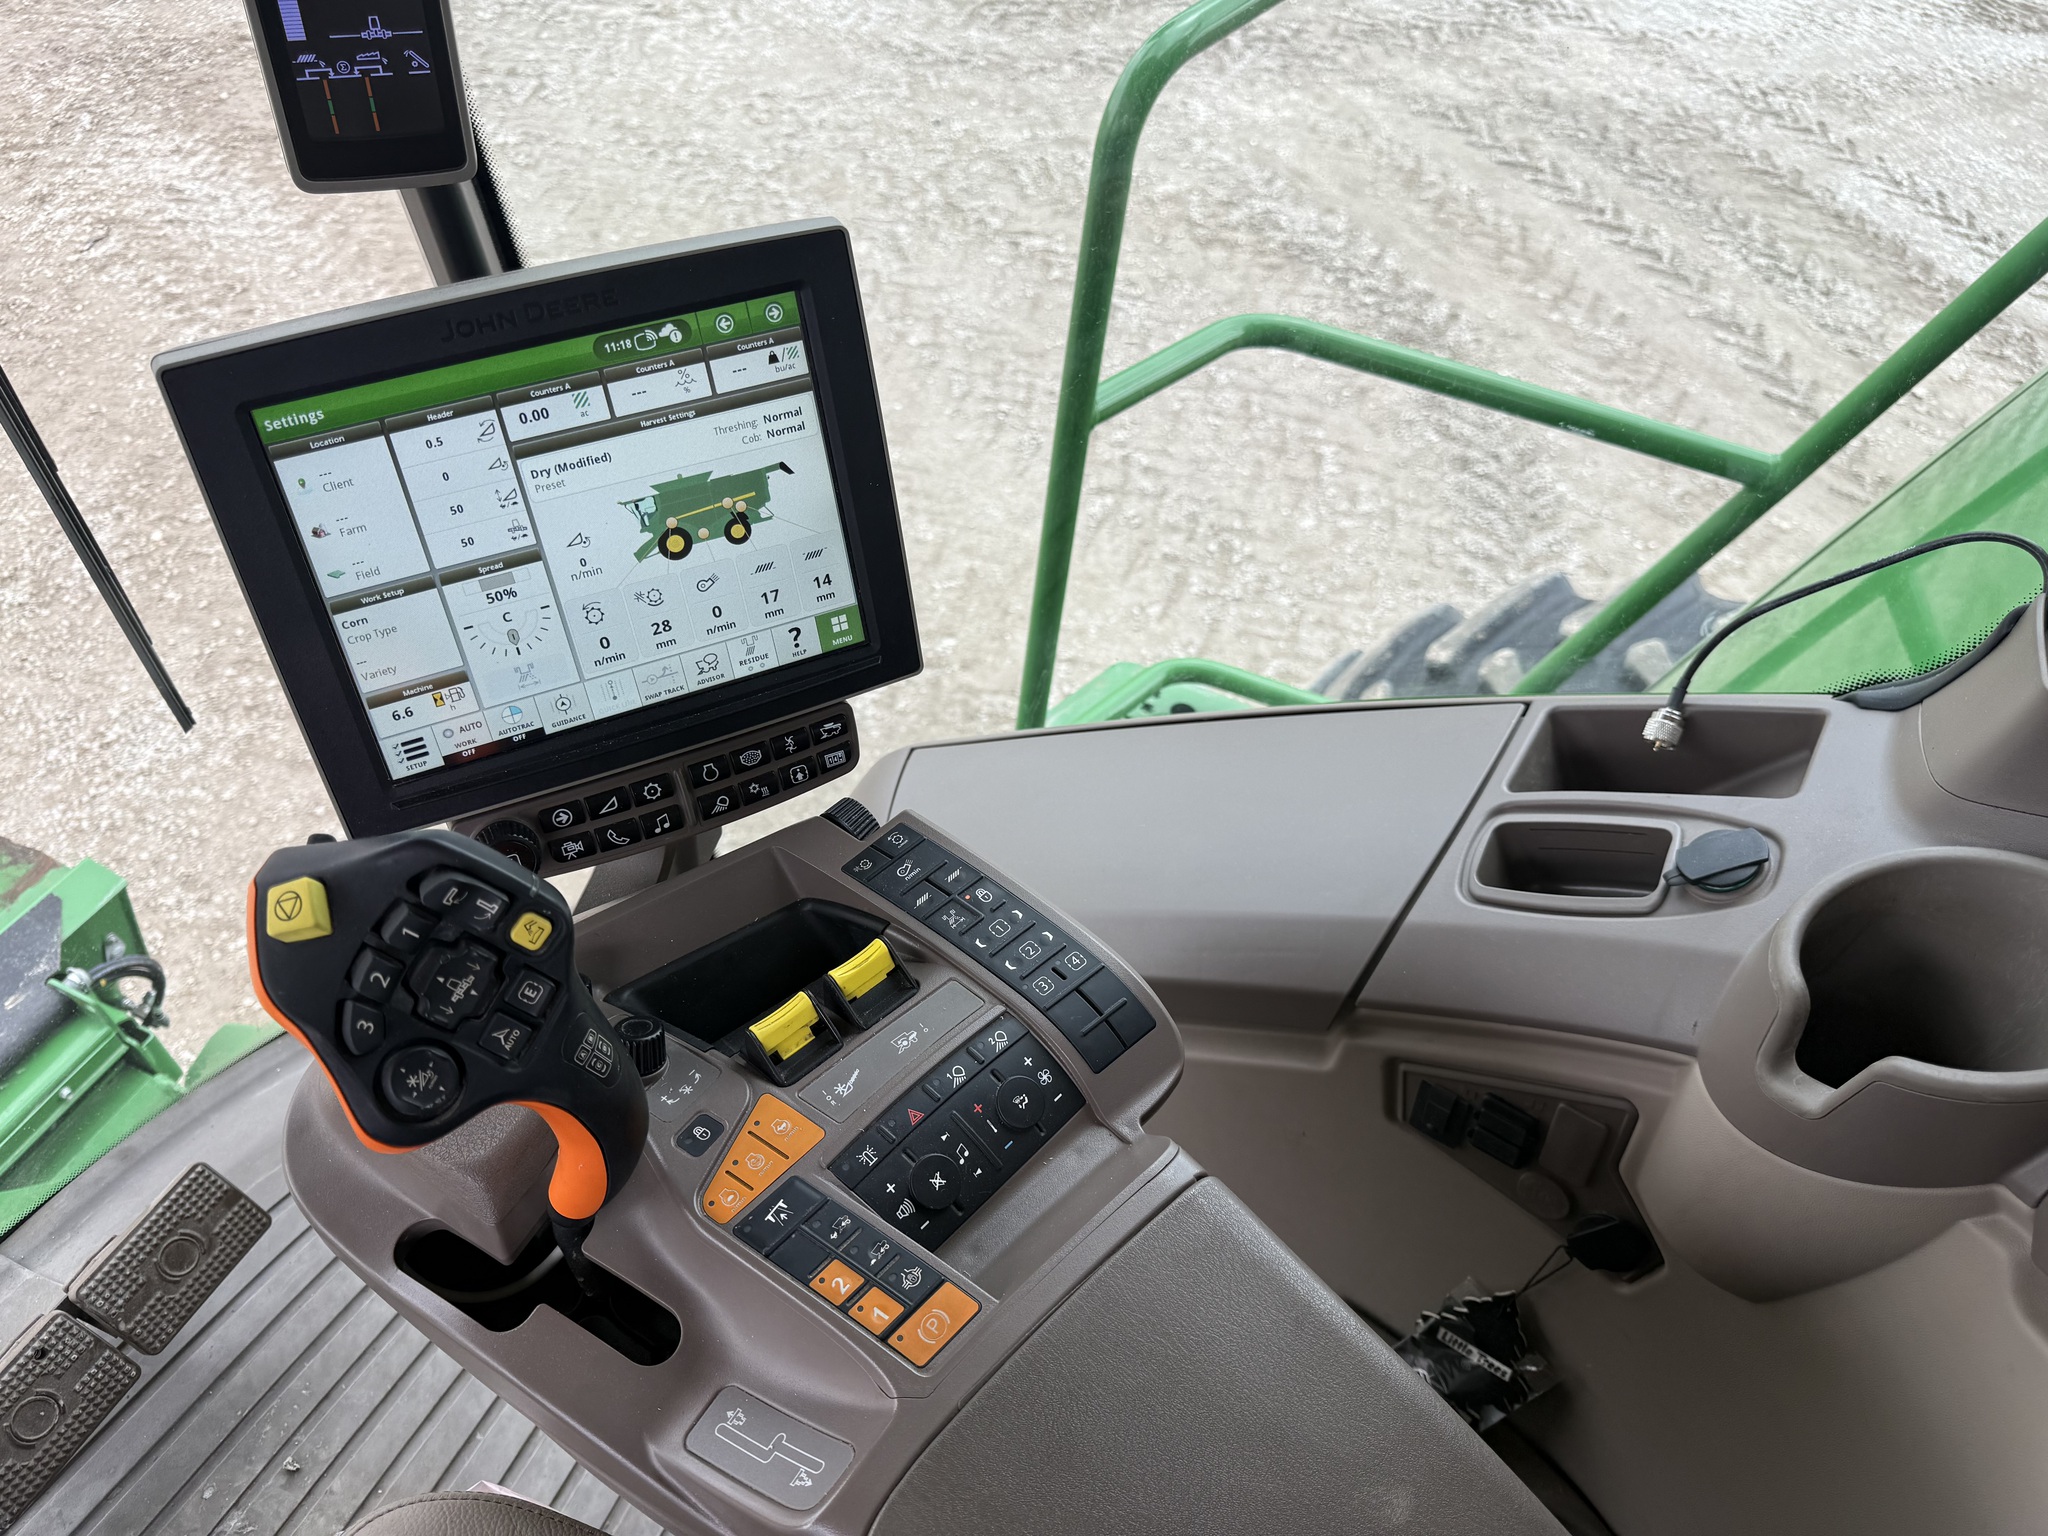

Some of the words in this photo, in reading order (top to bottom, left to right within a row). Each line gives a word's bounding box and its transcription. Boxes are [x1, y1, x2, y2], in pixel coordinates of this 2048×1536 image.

[440, 309, 518, 342] JOHN
[604, 338, 632, 354] 11:18
[737, 339, 767, 352] Counters
[767, 337, 775, 345] A
[636, 361, 668, 374] Counters
[668, 359, 675, 367] A
[775, 362, 796, 373] bu/ac
[530, 385, 563, 398] Counters
[564, 383, 571, 391] A
[264, 409, 325, 432] Settings
[427, 409, 454, 422] Header
[518, 407, 550, 425] 0.00
[640, 415, 666, 428] Harvest
[667, 409, 696, 422] Settings
[713, 418, 759, 437] Threshing:
[763, 406, 803, 425] Normal
[742, 432, 762, 446] Cob:
[766, 421, 806, 440] Normal
[310, 435, 345, 449] Location
[425, 437, 444, 450] 0.5
[530, 464, 552, 481] Dry
[554, 452, 613, 476] (Modified)
[442, 472, 449, 482] 0
[322, 477, 354, 493] Client
[534, 478, 566, 493] Preset
[450, 504, 464, 516] 50
[339, 523, 367, 538] Farm
[461, 536, 475, 548] 50
[478, 562, 504, 575] Spread
[580, 558, 587, 567] 0
[355, 566, 381, 581] Field
[570, 566, 603, 581] n/min
[813, 574, 832, 588] 14
[360, 593, 382, 605] Work
[382, 588, 405, 600] Setup
[486, 587, 518, 605] 50%
[761, 589, 779, 605] 17
[817, 591, 836, 603] mm
[502, 612, 513, 622] C
[712, 605, 722, 618] 0
[765, 607, 784, 619] mm
[341, 617, 369, 631] Corn
[651, 619, 672, 636] 28
[706, 620, 736, 635] n/min
[347, 631, 372, 645] Crop
[372, 625, 398, 641] Type
[832, 635, 853, 646] MENU
[600, 636, 611, 649] 0
[656, 638, 677, 650] mm
[594, 652, 626, 667] n/min
[739, 653, 769, 667] RESIDUE
[792, 649, 807, 658] HELP
[360, 665, 397, 681] Variety
[696, 673, 725, 686] ADVISOR
[402, 683, 433, 697] Machine
[644, 690, 662, 701] SWAP
[663, 685, 685, 697] TRACK
[392, 706, 414, 722] 6.6
[551, 714, 586, 728] GUIDANCE
[459, 721, 483, 734] AUTO
[498, 721, 535, 736] AUTOTRAC
[454, 738, 477, 749] WORK
[513, 733, 526, 742] OFF
[462, 748, 476, 757] OFF
[406, 761, 427, 771] SETUP
[402, 926, 420, 939] 1
[995, 924, 1005, 933] 1
[1025, 945, 1035, 955] 2
[1071, 955, 1081, 966] 4
[370, 972, 390, 989] 2
[1039, 981, 1049, 991] 3
[524, 987, 537, 998] E
[357, 1021, 374, 1034] 3
[504, 1029, 520, 1051] AUTO
[832, 1277, 850, 1294] 2
[872, 1307, 889, 1320] 1
[926, 1318, 938, 1334] P
[1441, 1331, 1473, 1356] Little
[1477, 1351, 1507, 1378] Trees
